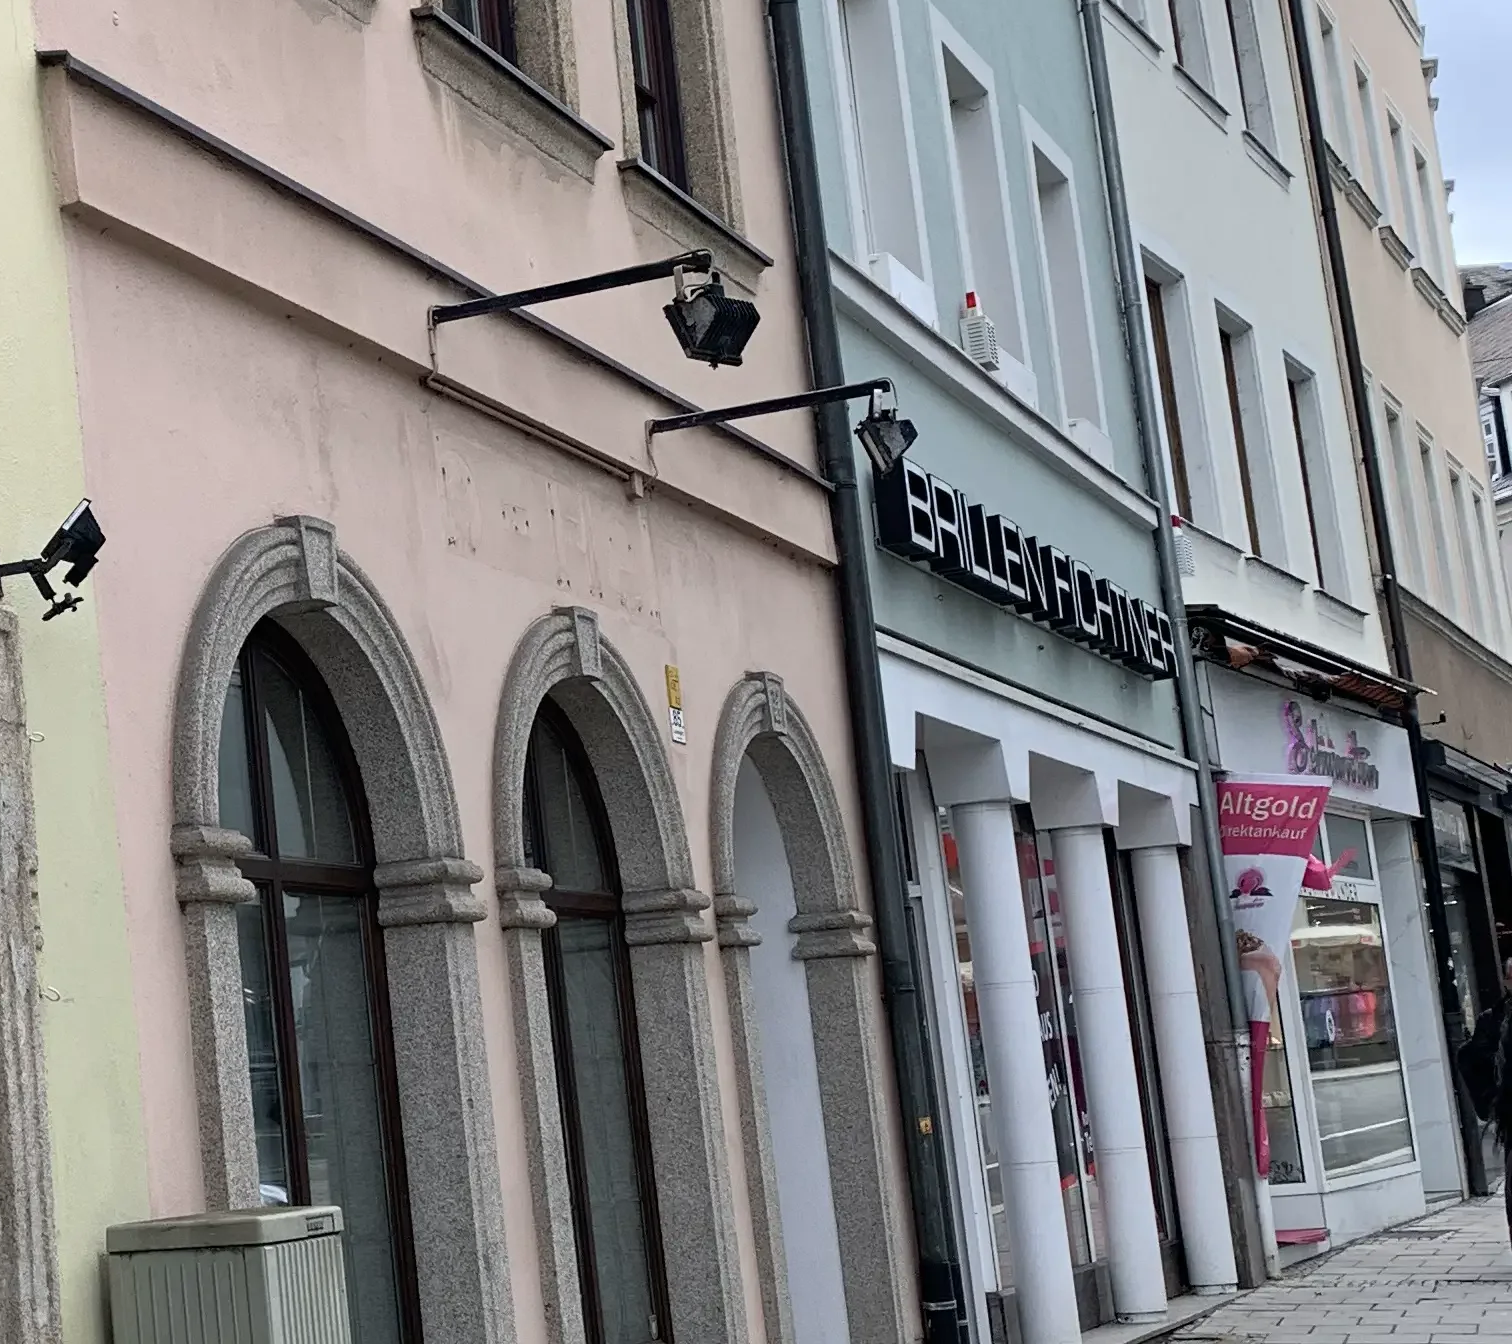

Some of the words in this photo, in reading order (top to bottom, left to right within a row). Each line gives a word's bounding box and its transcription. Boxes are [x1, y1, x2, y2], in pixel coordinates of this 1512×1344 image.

[901, 456, 1048, 612] BRILLEN
[1050, 545, 1179, 677] FICHTNER
[1219, 791, 1318, 821] Altgold
